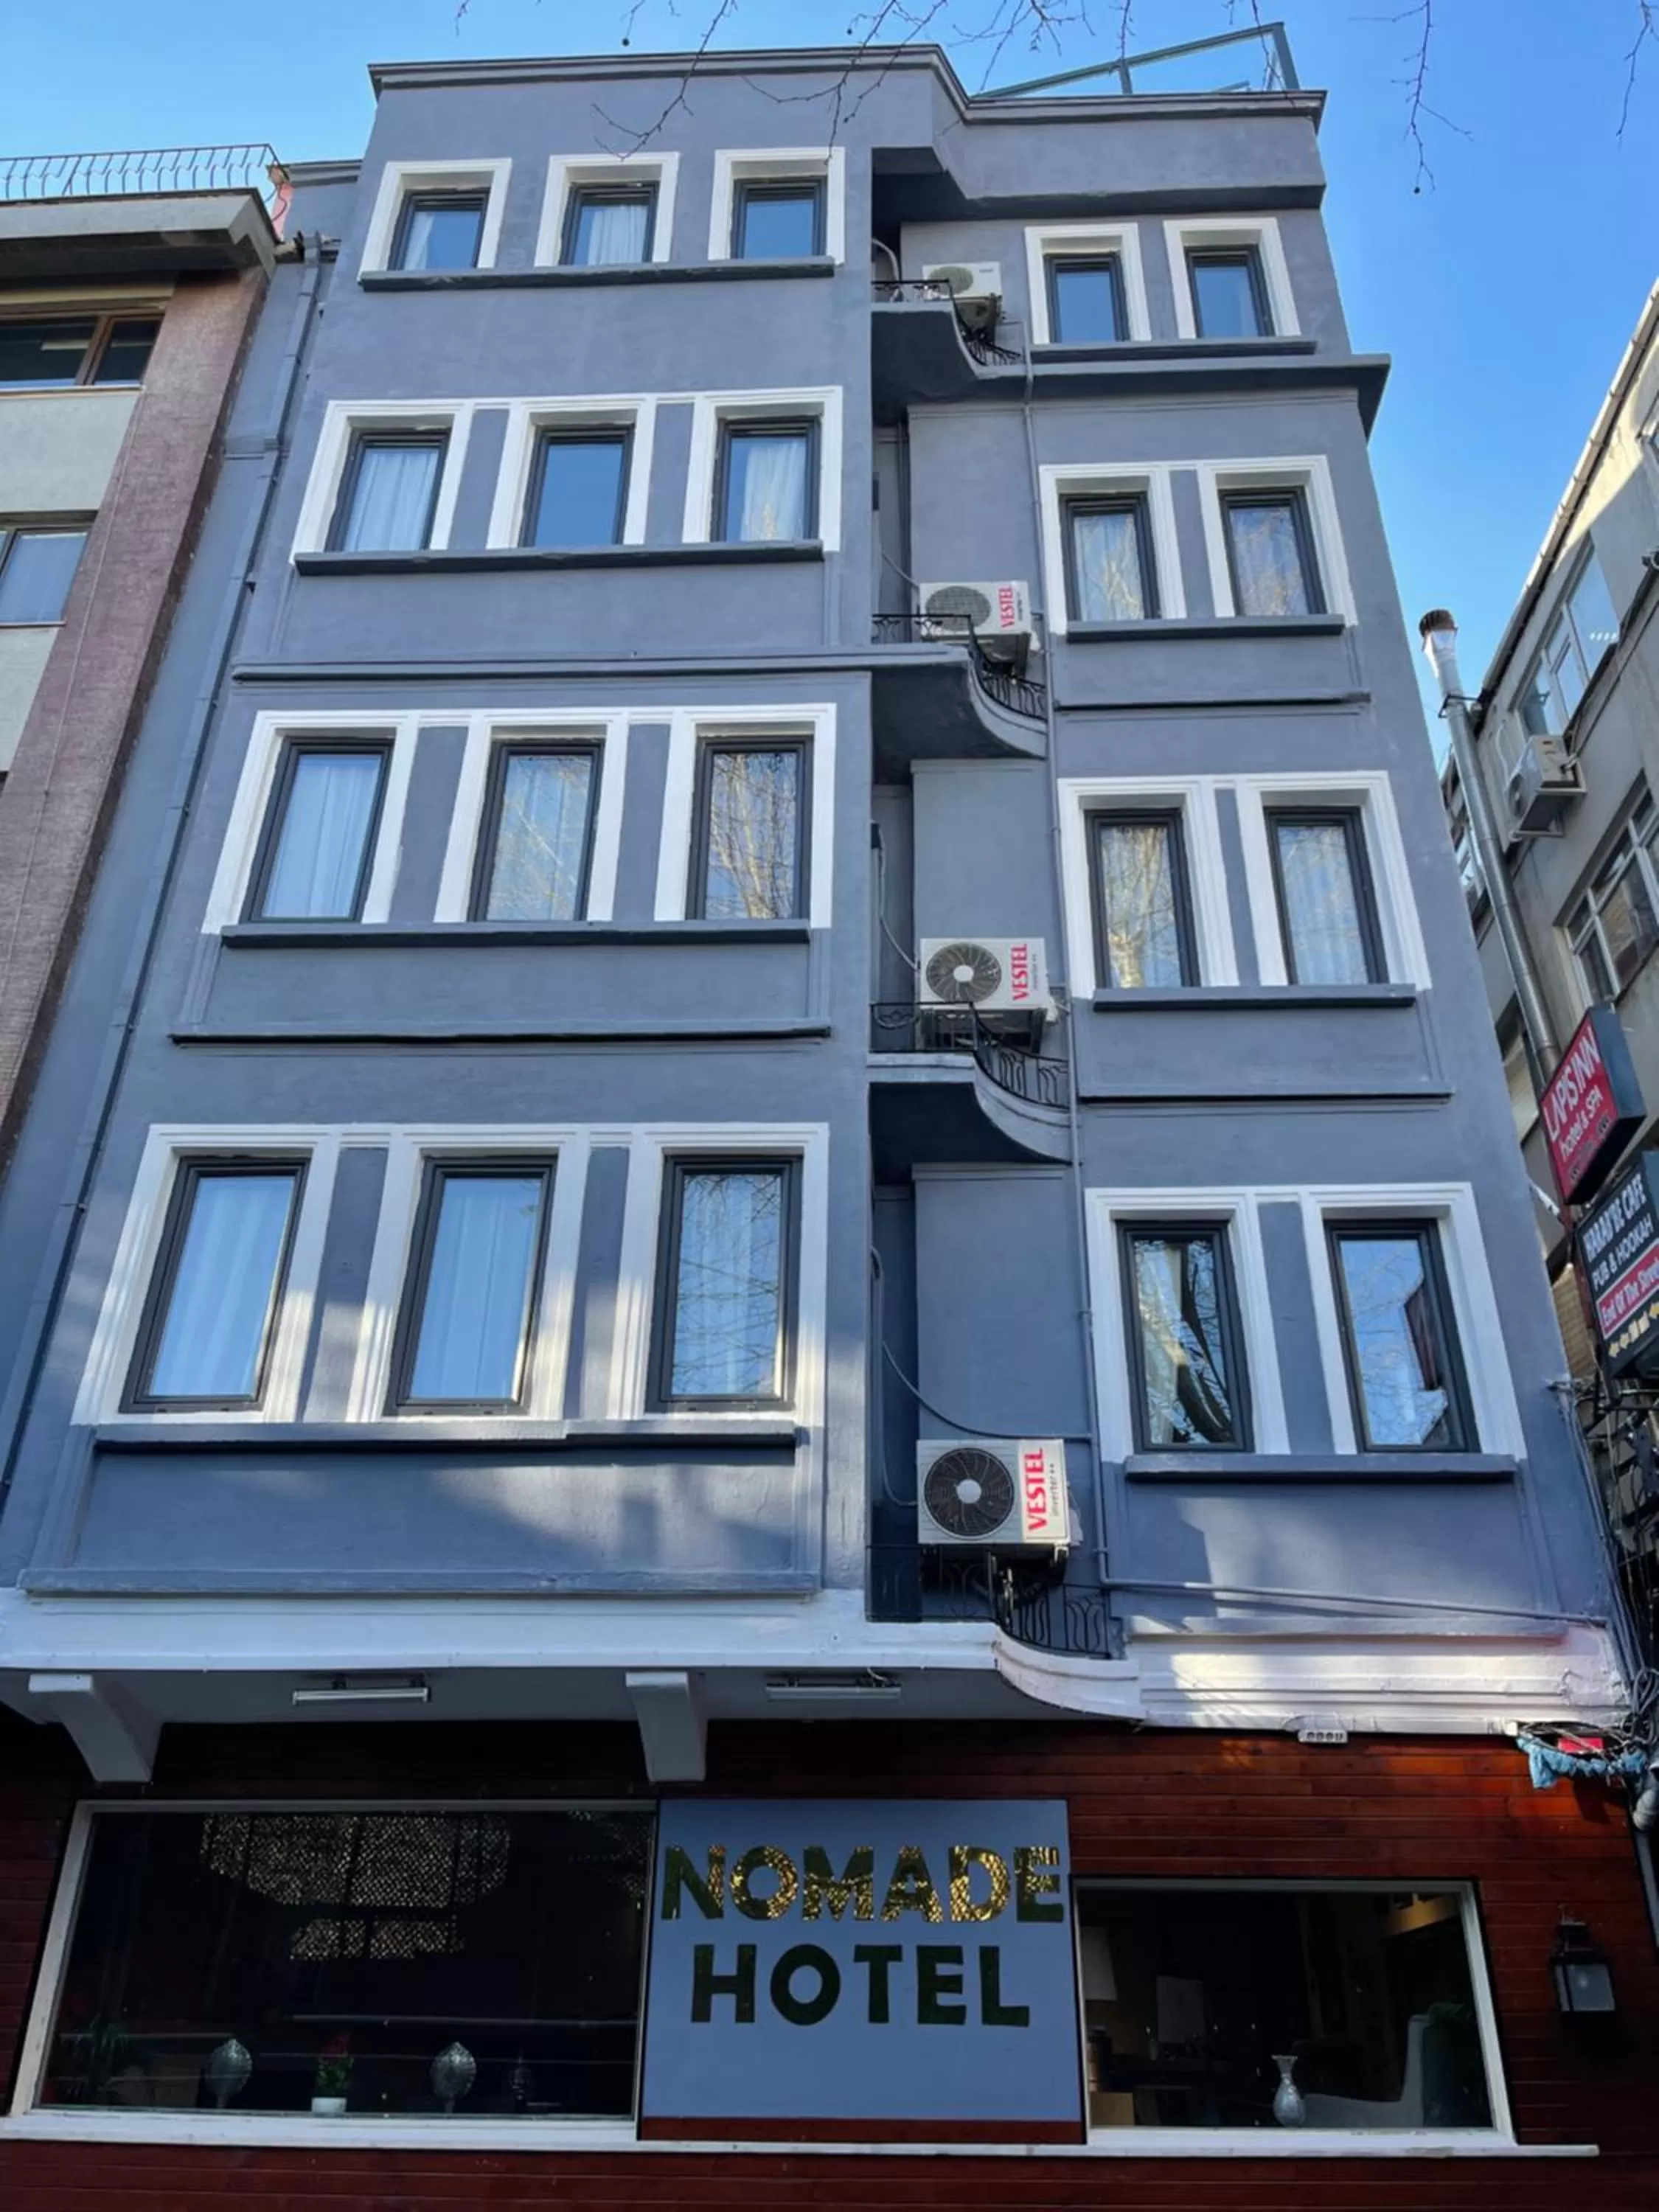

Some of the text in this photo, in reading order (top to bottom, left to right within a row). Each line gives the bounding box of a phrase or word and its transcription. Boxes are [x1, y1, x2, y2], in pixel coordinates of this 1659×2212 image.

[999, 586, 1015, 628] VESTEL
[1011, 943, 1029, 1001] VESTEL
[1024, 1446, 1048, 1531] VESTEL
[661, 1845, 1065, 1923] NOMADE
[691, 1943, 1030, 2027] HOTEL
